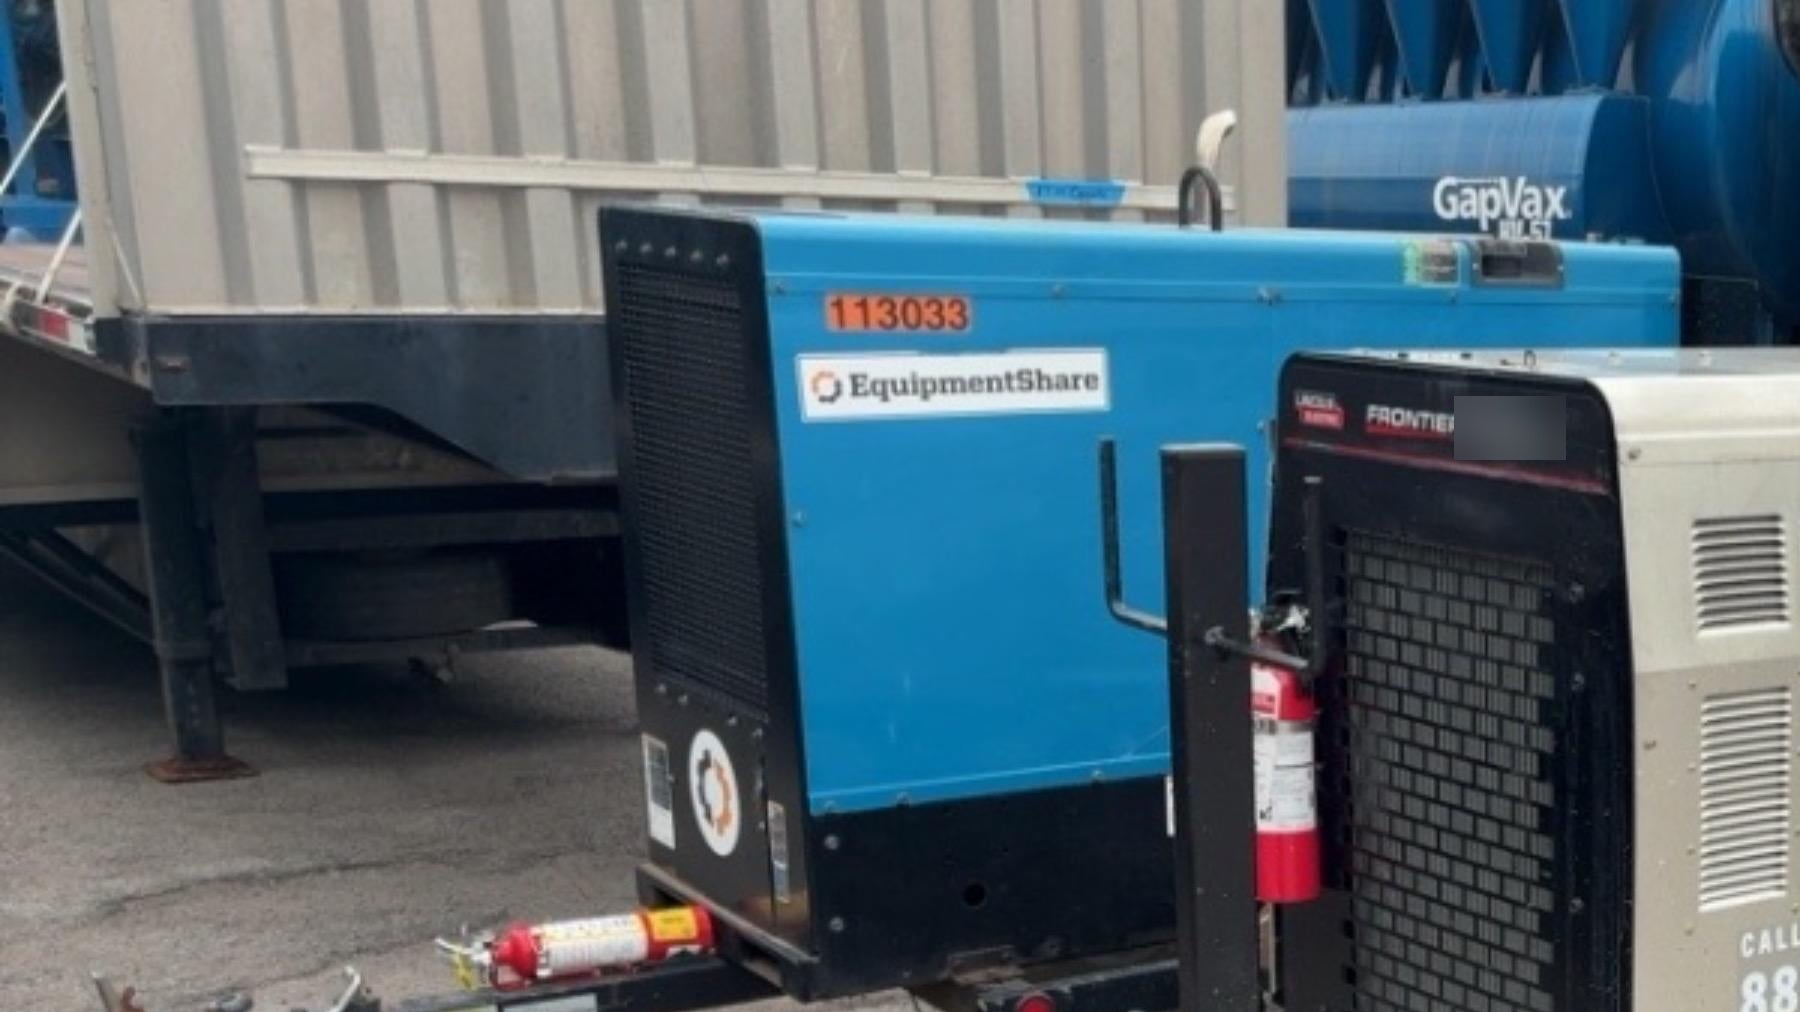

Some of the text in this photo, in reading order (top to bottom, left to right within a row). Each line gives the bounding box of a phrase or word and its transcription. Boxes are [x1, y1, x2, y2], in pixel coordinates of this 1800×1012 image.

[1432, 175, 1568, 231] GapVax
[829, 296, 970, 331] 113033
[848, 367, 1100, 403] EquipmentShare
